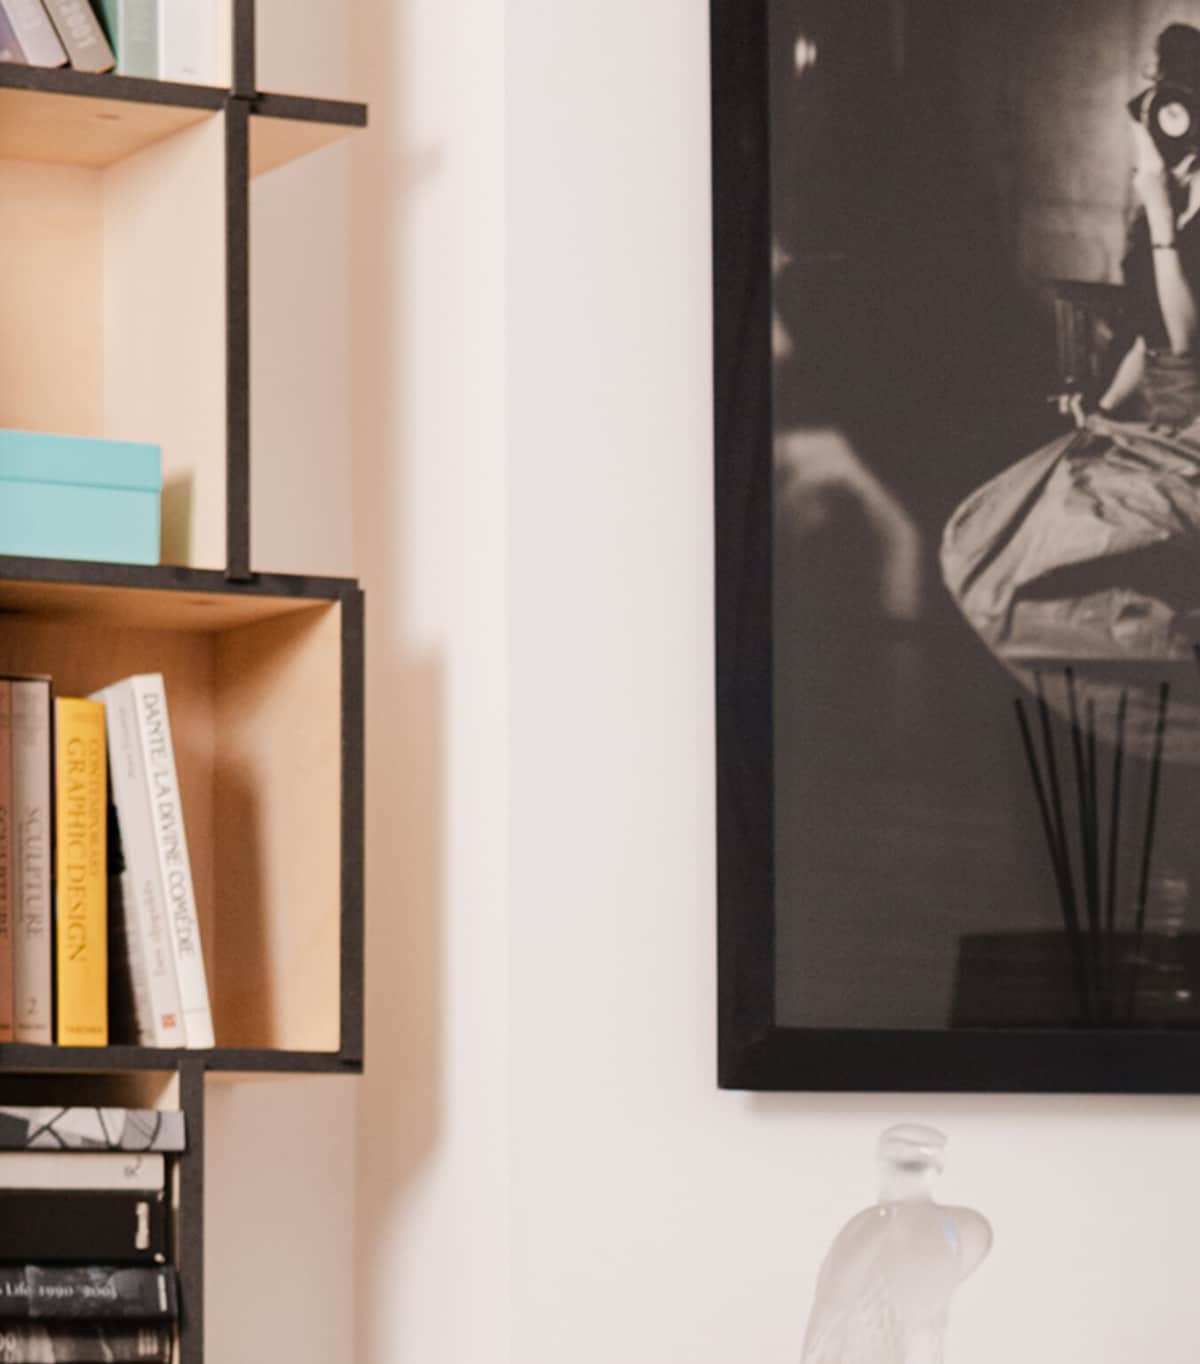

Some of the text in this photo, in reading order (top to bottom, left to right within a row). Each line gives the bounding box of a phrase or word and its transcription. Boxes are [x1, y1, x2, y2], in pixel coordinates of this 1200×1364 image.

[153, 770, 175, 799] LA
[26, 806, 43, 938] SCULPTURE
[66, 738, 88, 962] GRAPHIC DESIGN
[159, 802, 183, 866] DIVINE
[168, 871, 196, 959] COMÉDIE
